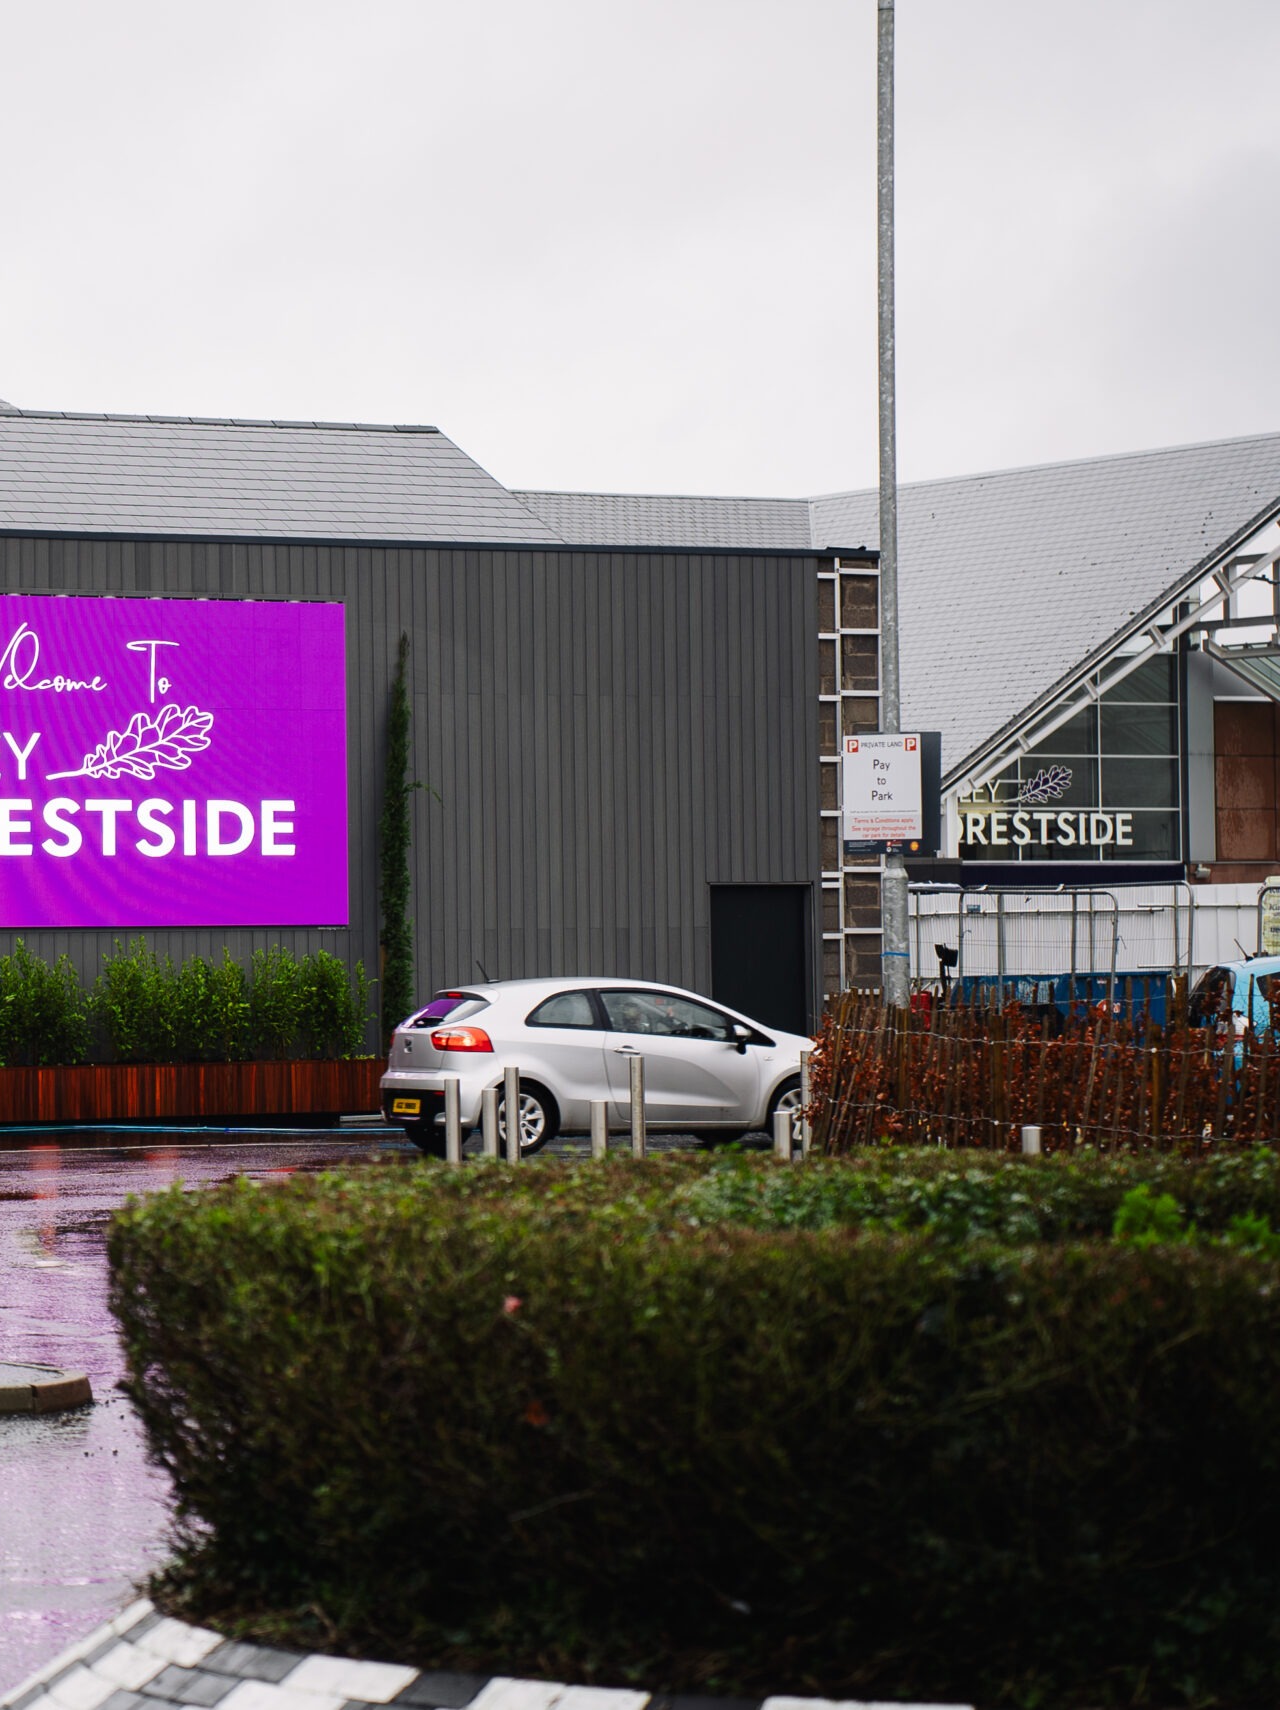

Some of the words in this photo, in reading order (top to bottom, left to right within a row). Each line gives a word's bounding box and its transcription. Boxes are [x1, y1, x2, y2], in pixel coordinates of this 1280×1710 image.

[126, 639, 180, 703] To
[873, 759, 891, 771] Pay
[877, 777, 887, 785] to
[871, 790, 893, 801] Park
[958, 811, 1133, 846] RESTSIDE
